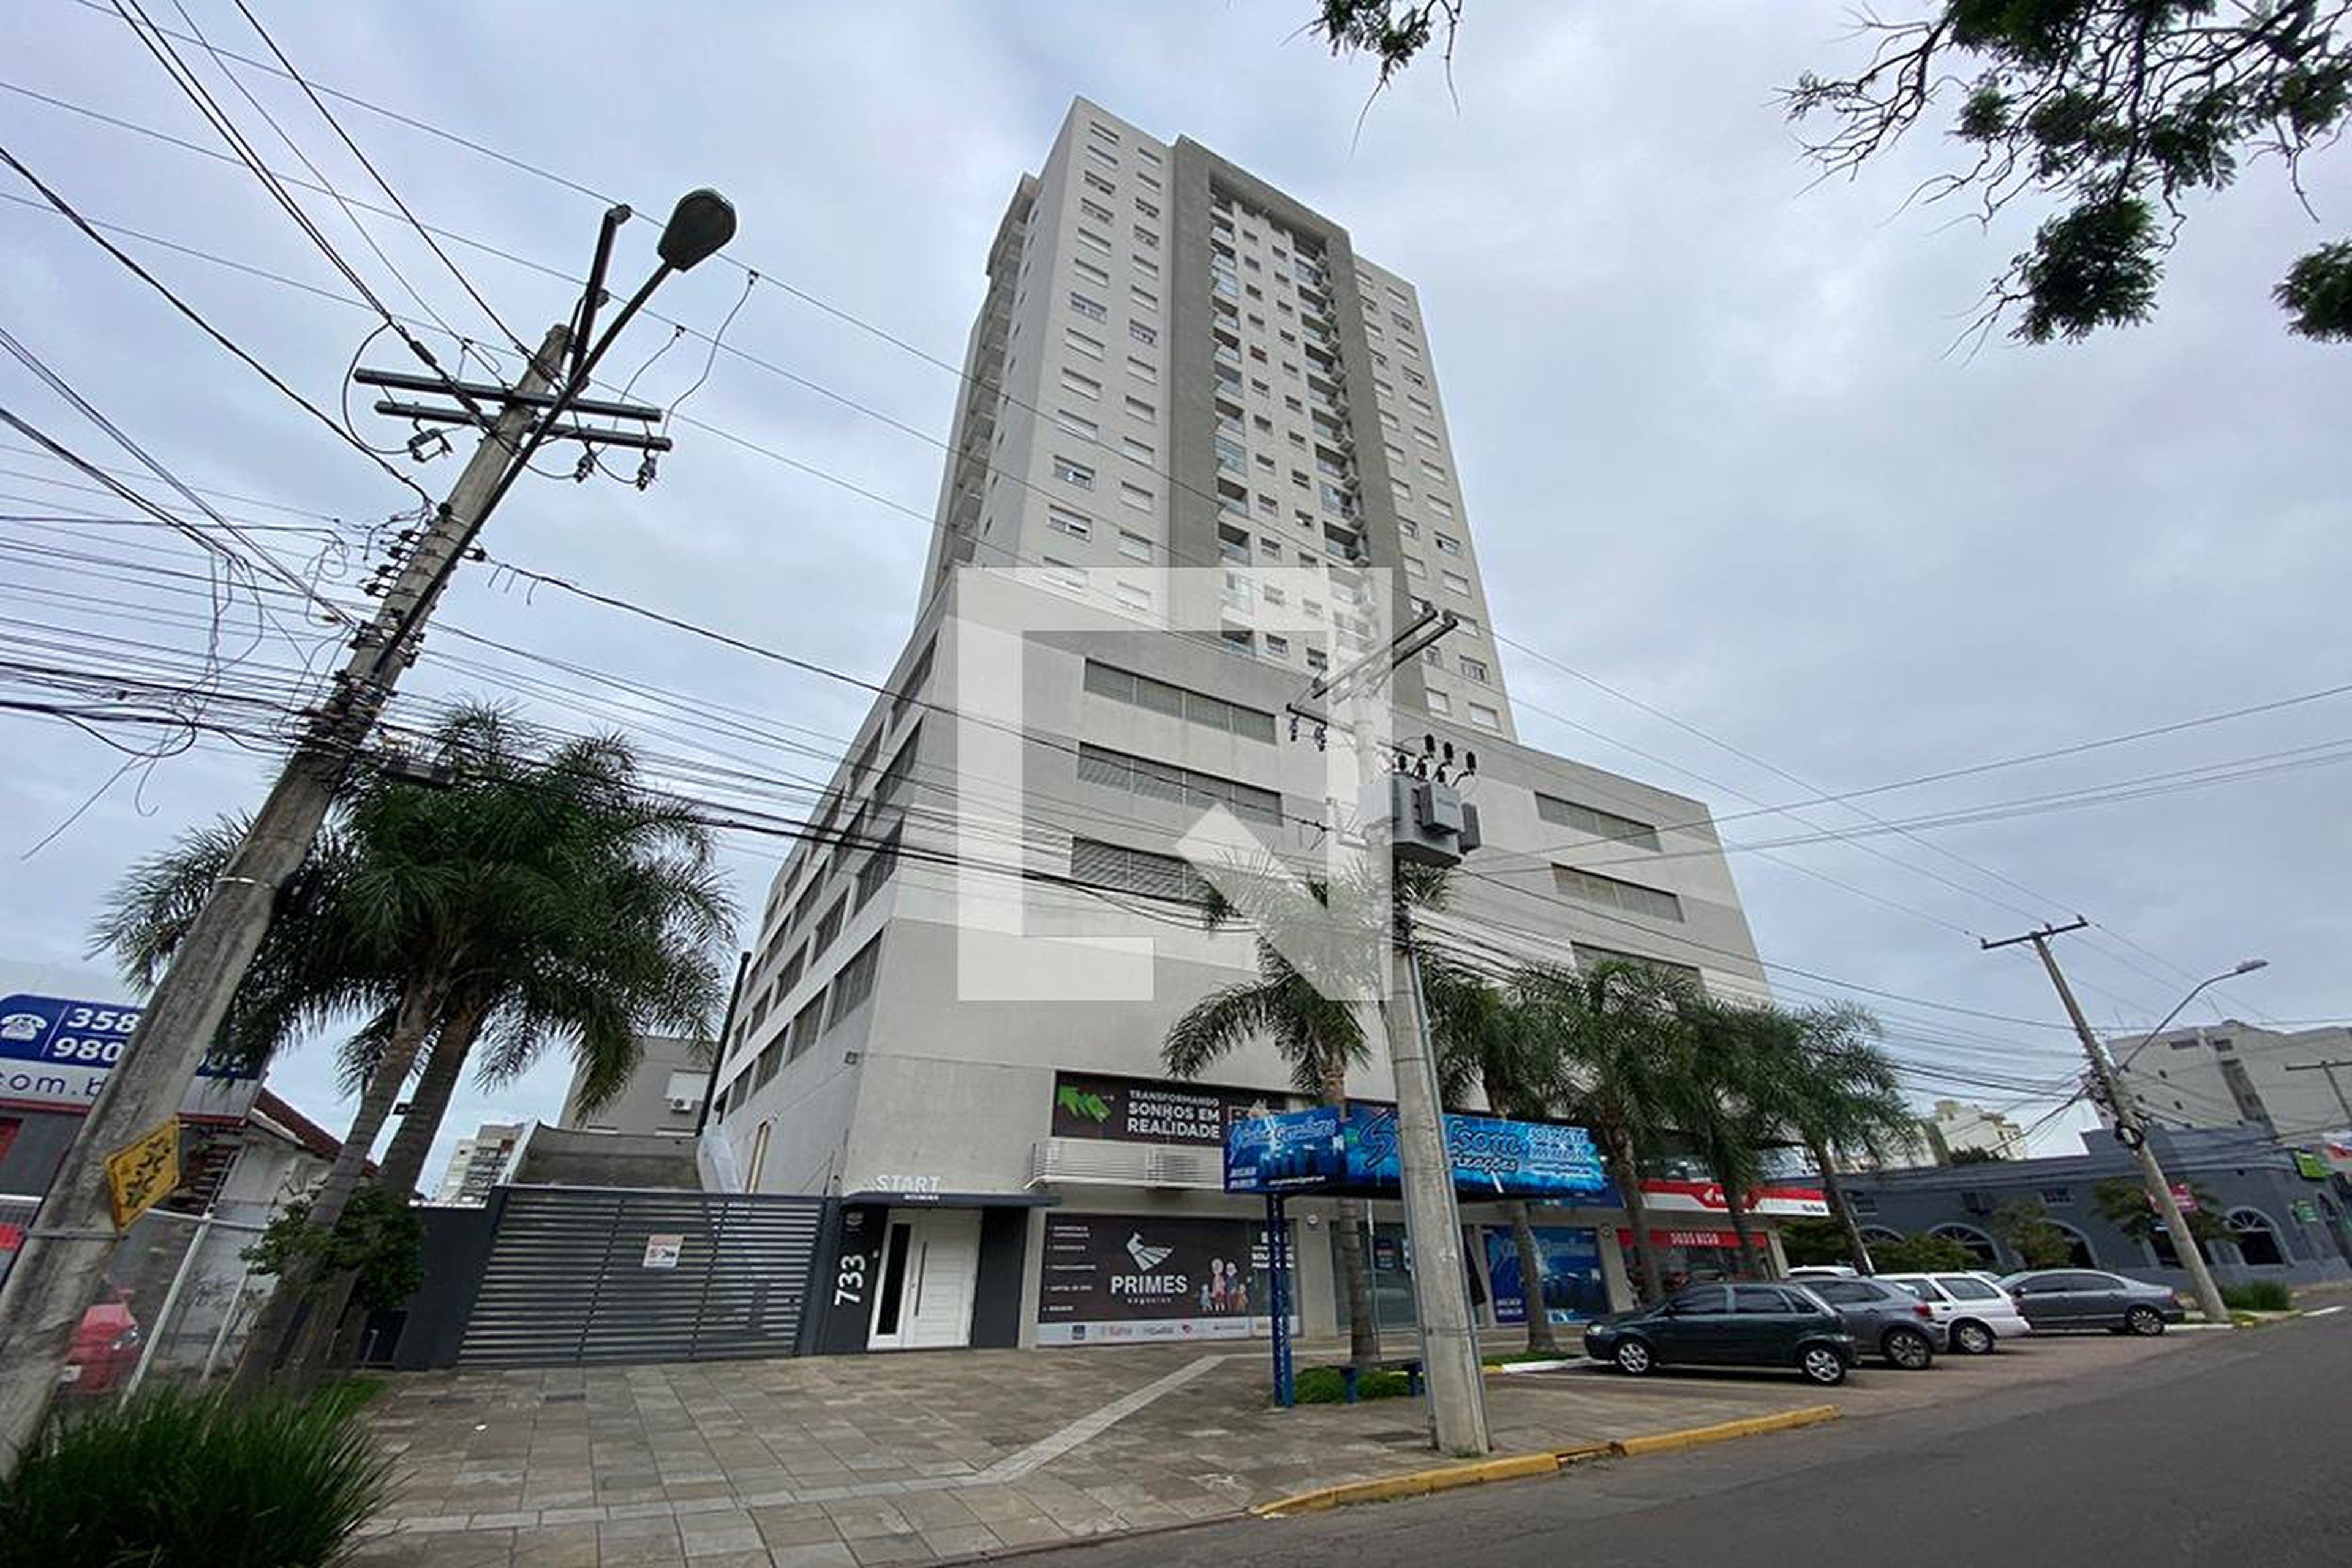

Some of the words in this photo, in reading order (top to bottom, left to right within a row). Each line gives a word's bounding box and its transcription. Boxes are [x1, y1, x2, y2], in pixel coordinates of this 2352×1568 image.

[1129, 1090, 1219, 1107] TRANSFORMANDO
[1128, 1101, 1194, 1120] SONHOS
[1198, 1107, 1220, 1122] EM
[1127, 1117, 1221, 1139] REALIDADE
[876, 1175, 941, 1193] START
[834, 1254, 866, 1306] 733
[1110, 1275, 1188, 1295] PRIMES
